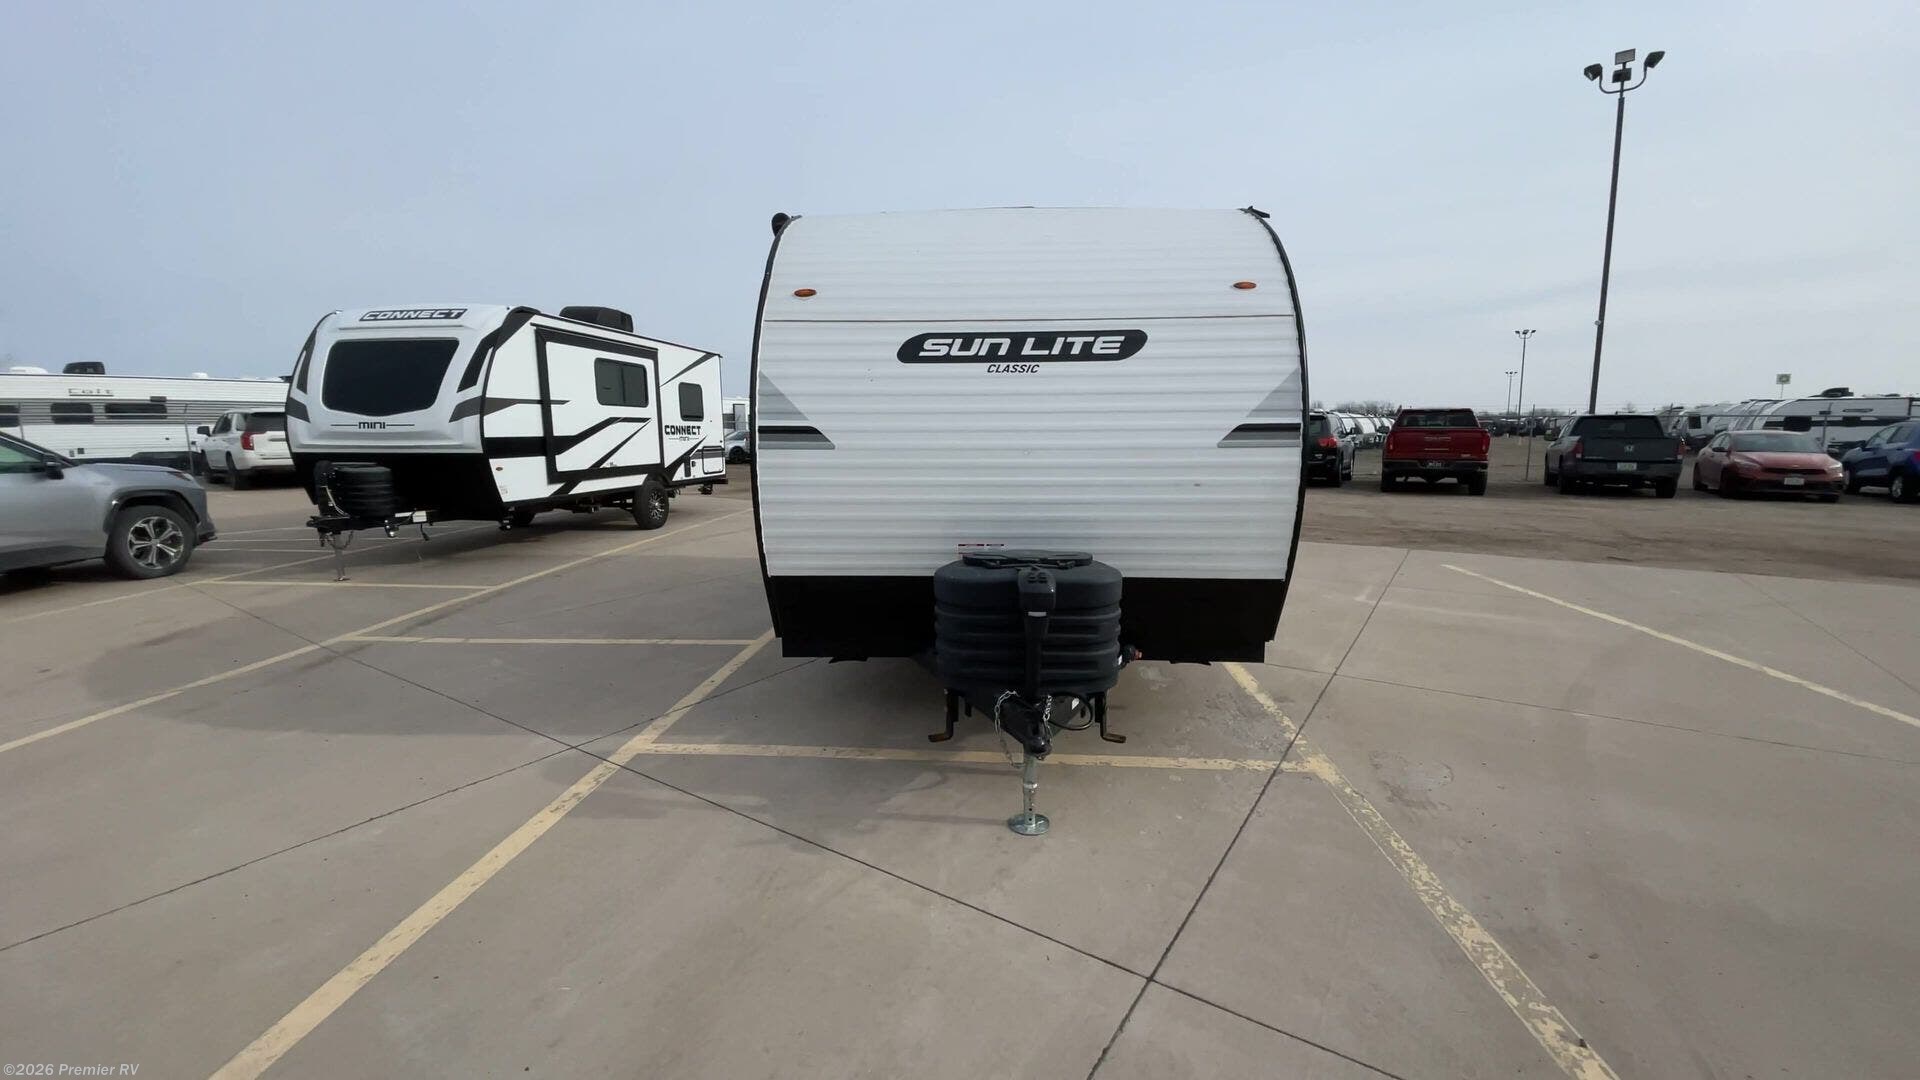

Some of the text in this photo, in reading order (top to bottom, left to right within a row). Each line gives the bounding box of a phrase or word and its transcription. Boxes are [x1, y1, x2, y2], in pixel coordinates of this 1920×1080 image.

[361, 309, 465, 320] CONNECT
[918, 335, 1126, 357] SUN LITE
[986, 363, 1040, 374] CLASSIC
[664, 424, 702, 436] CONNECT
